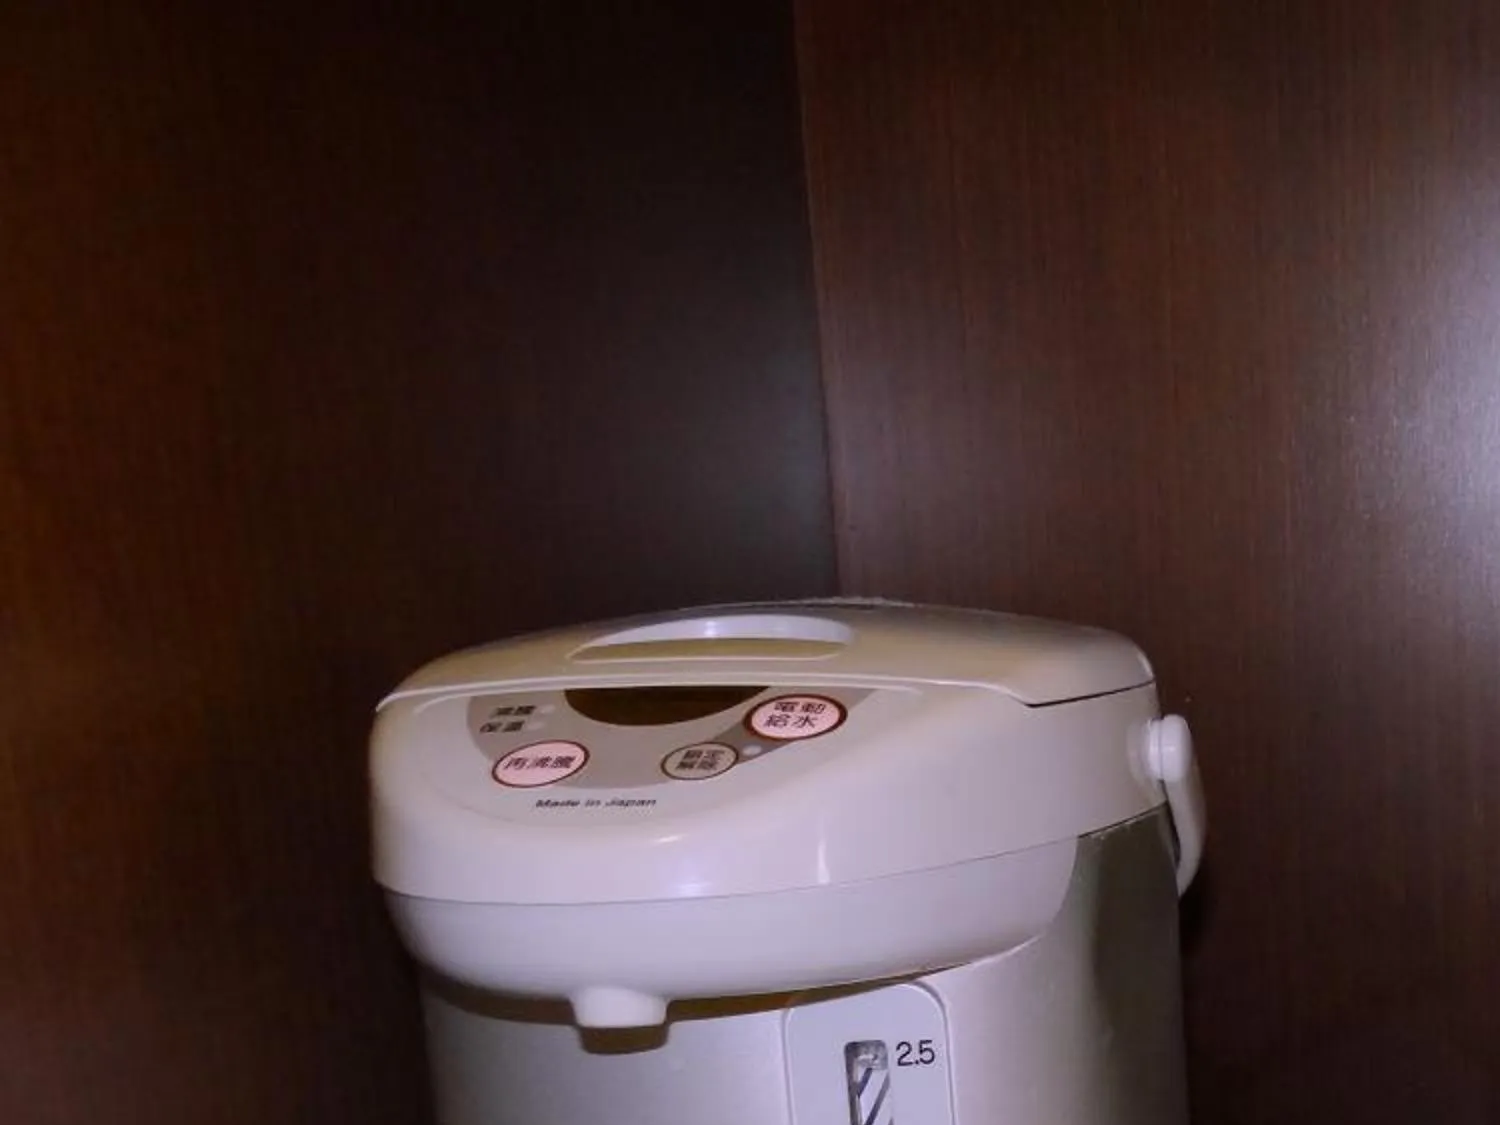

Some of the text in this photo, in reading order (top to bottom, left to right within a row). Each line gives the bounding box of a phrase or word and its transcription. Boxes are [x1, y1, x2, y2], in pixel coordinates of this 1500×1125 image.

[773, 701, 826, 715] 電動
[764, 714, 819, 729] 給水
[535, 799, 657, 808] Made in Japan
[896, 1040, 936, 1067] 2.5
